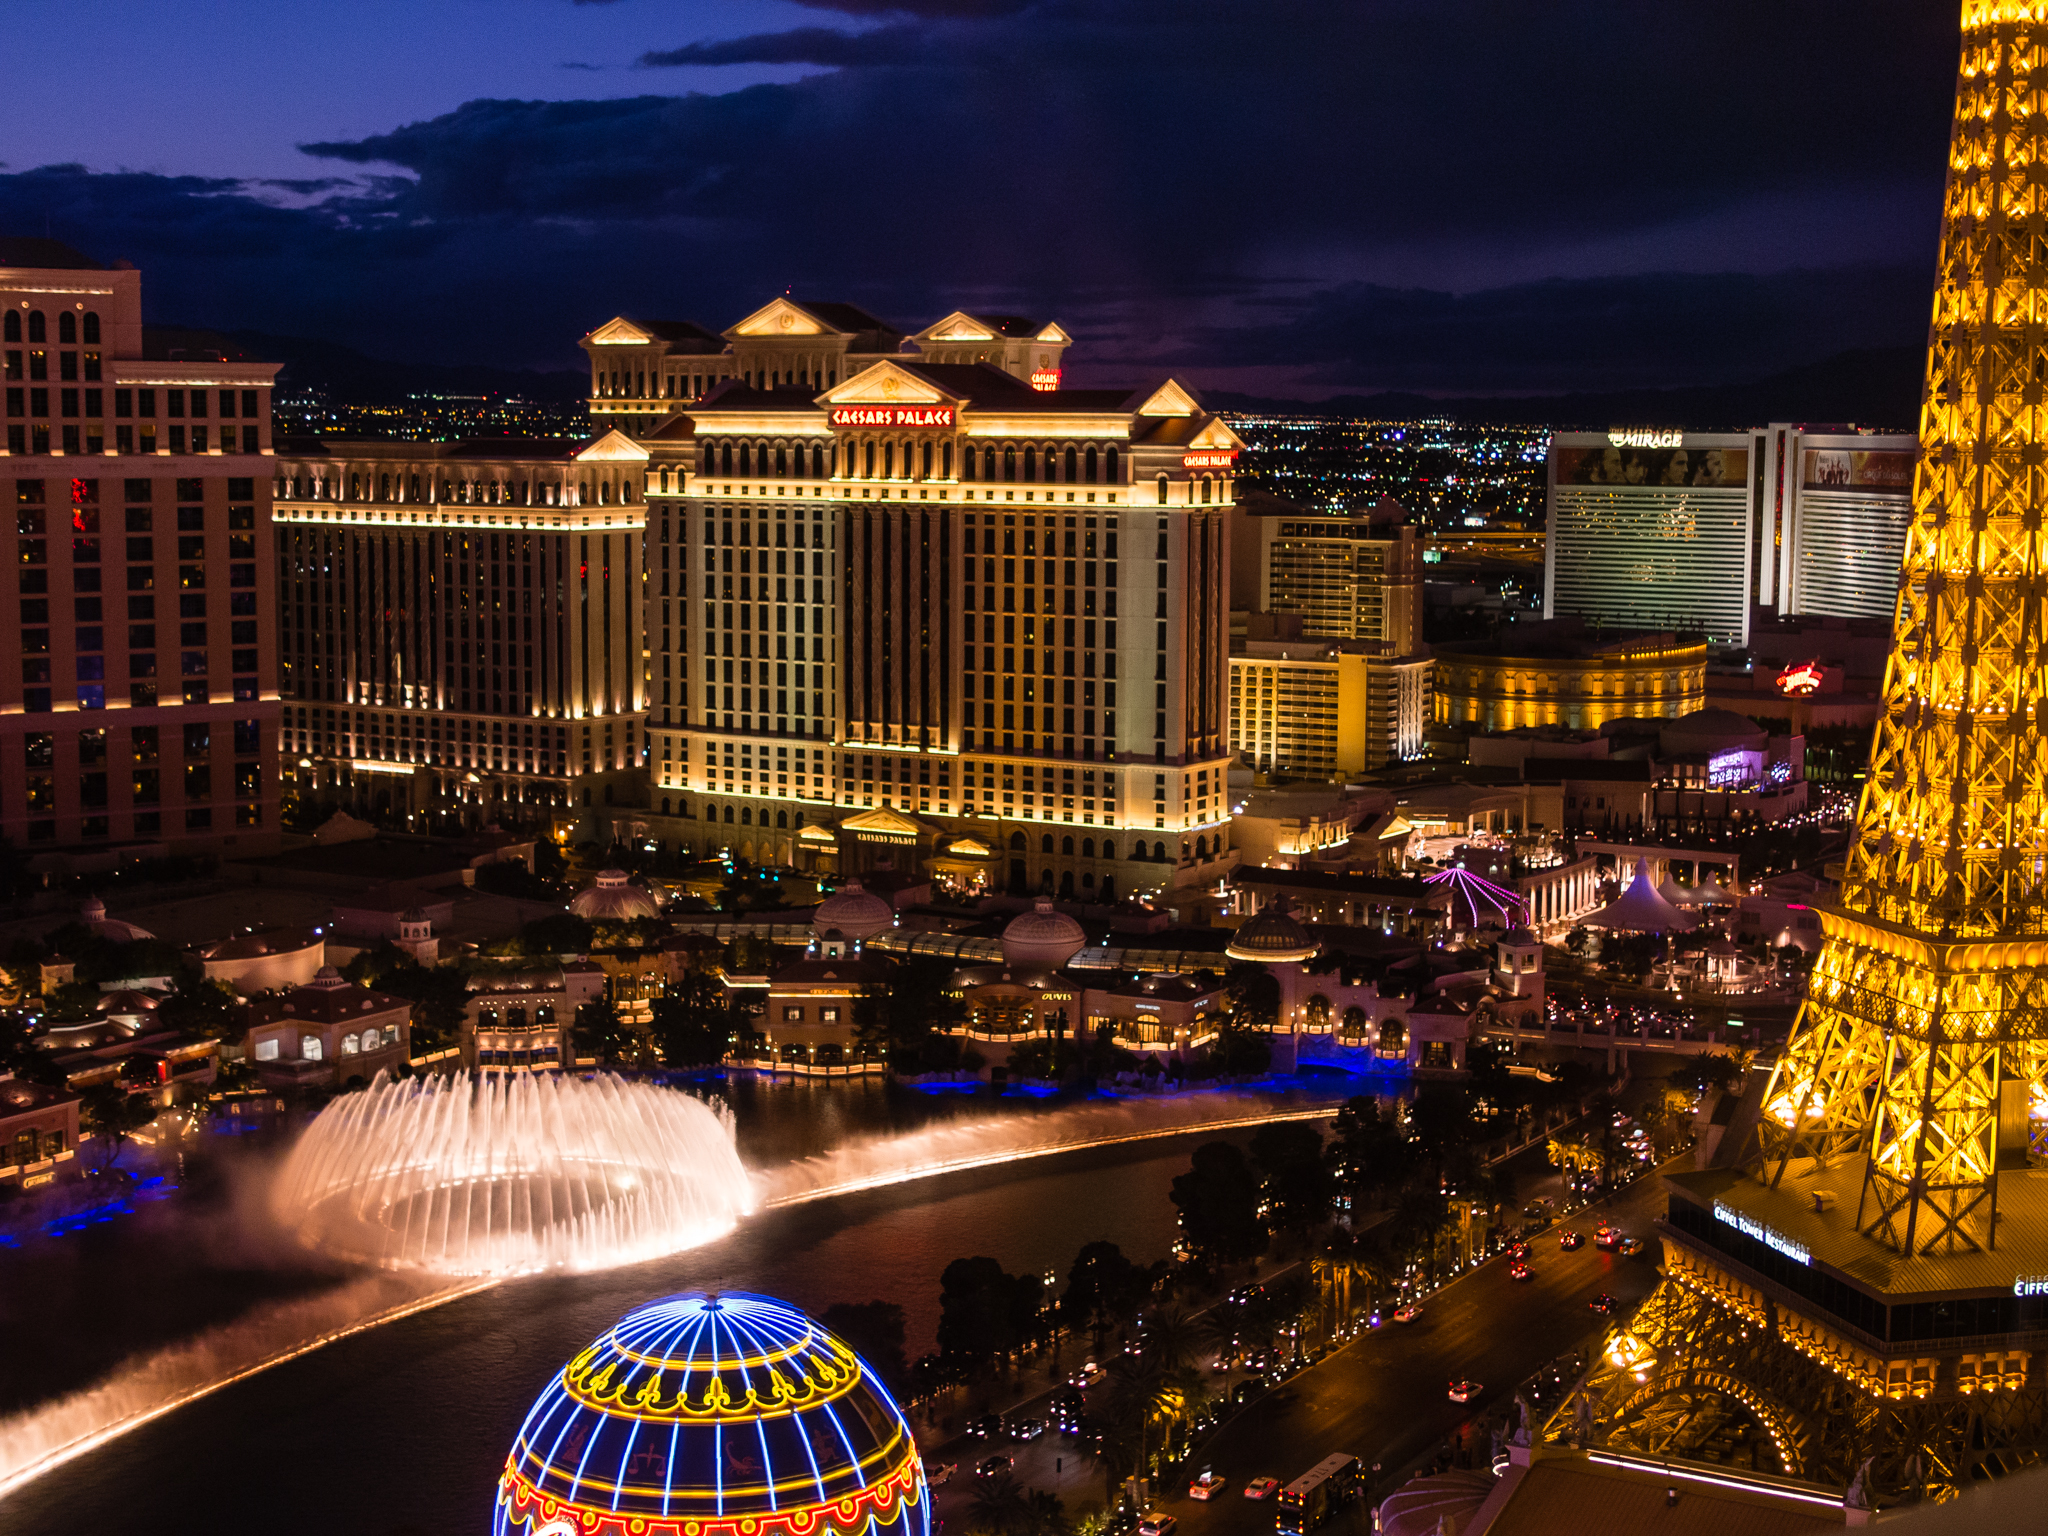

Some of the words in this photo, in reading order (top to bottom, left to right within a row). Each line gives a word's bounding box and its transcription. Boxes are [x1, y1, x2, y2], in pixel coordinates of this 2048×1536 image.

[1031, 373, 1058, 383] CAESARS
[832, 410, 893, 425] CAESARS
[896, 410, 951, 425] PALACE
[1608, 433, 1625, 442] THE
[1613, 433, 1683, 449] MIRAGE
[1183, 456, 1210, 467] CAESARS
[1210, 456, 1232, 467] PALACE
[1041, 993, 1072, 1001] OLIVES
[1714, 1206, 1738, 1229] EIFFEL
[1738, 1217, 1764, 1242] TOWER
[1765, 1232, 1811, 1267] RESTAURANT
